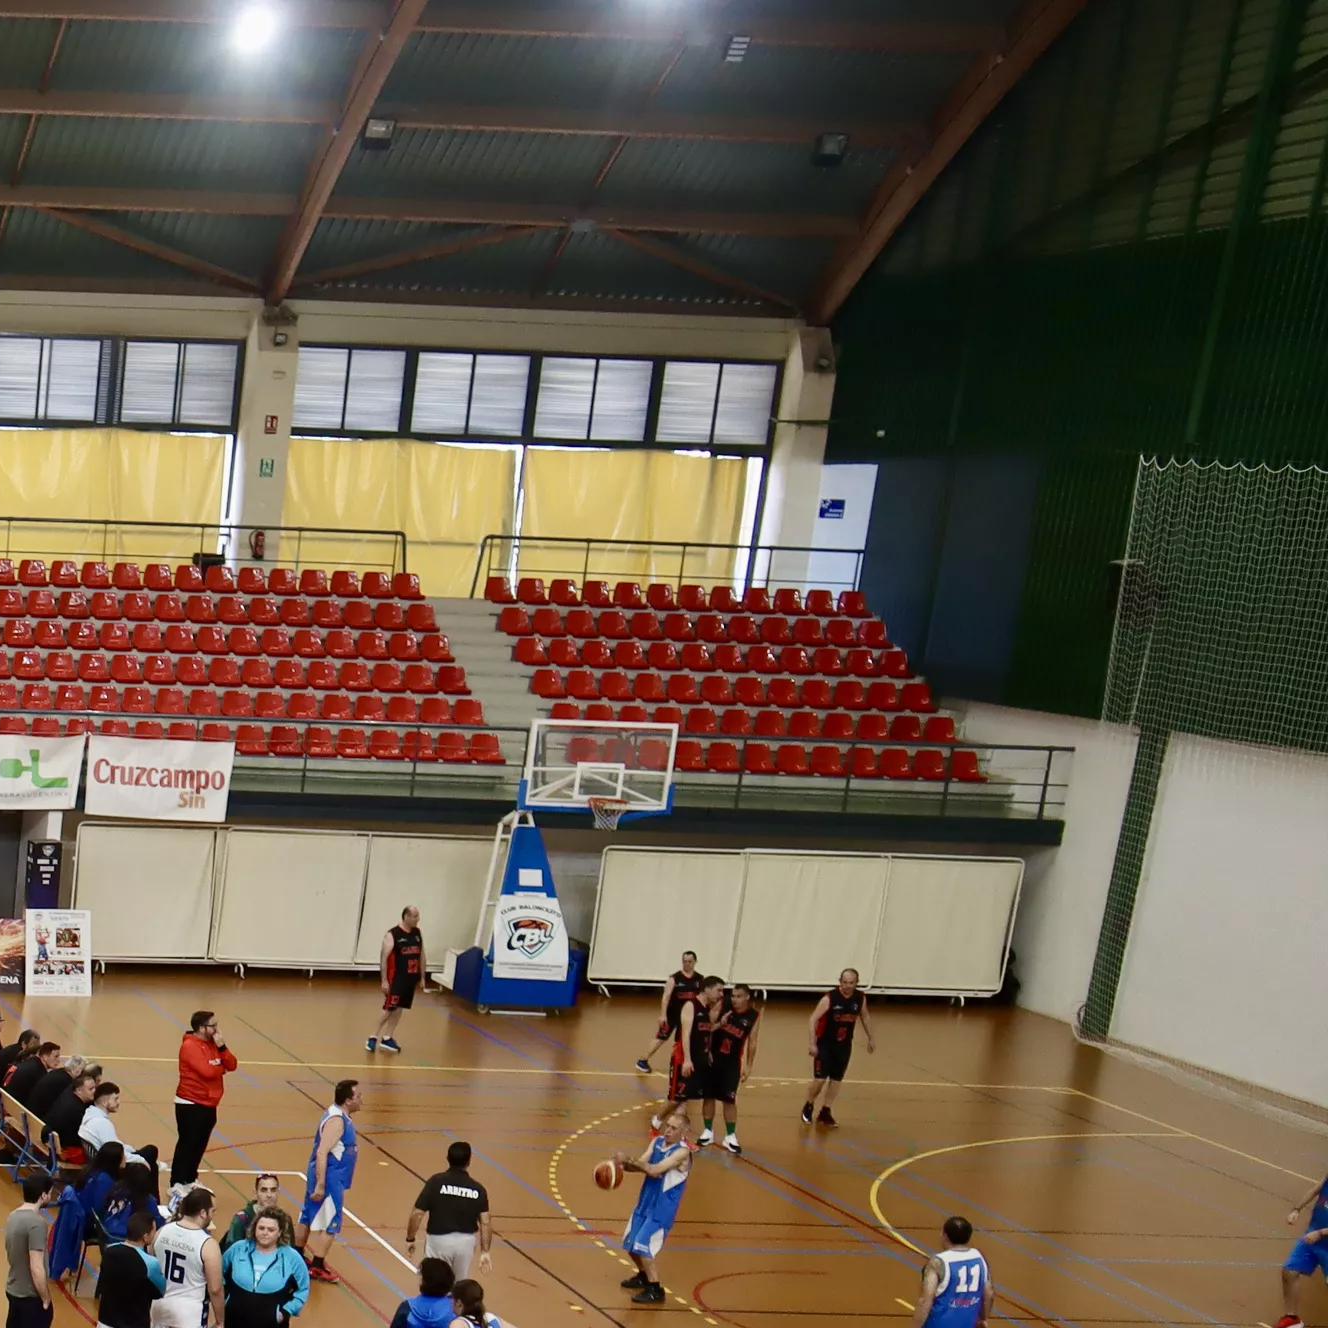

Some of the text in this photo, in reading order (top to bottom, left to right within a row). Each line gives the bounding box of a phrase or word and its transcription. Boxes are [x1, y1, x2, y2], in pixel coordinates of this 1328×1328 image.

[93, 757, 225, 796] Cruzcampo
[176, 791, 206, 809] Sin
[509, 927, 554, 950] CBL
[164, 1249, 187, 1285] 16
[955, 1263, 981, 1294] 11
